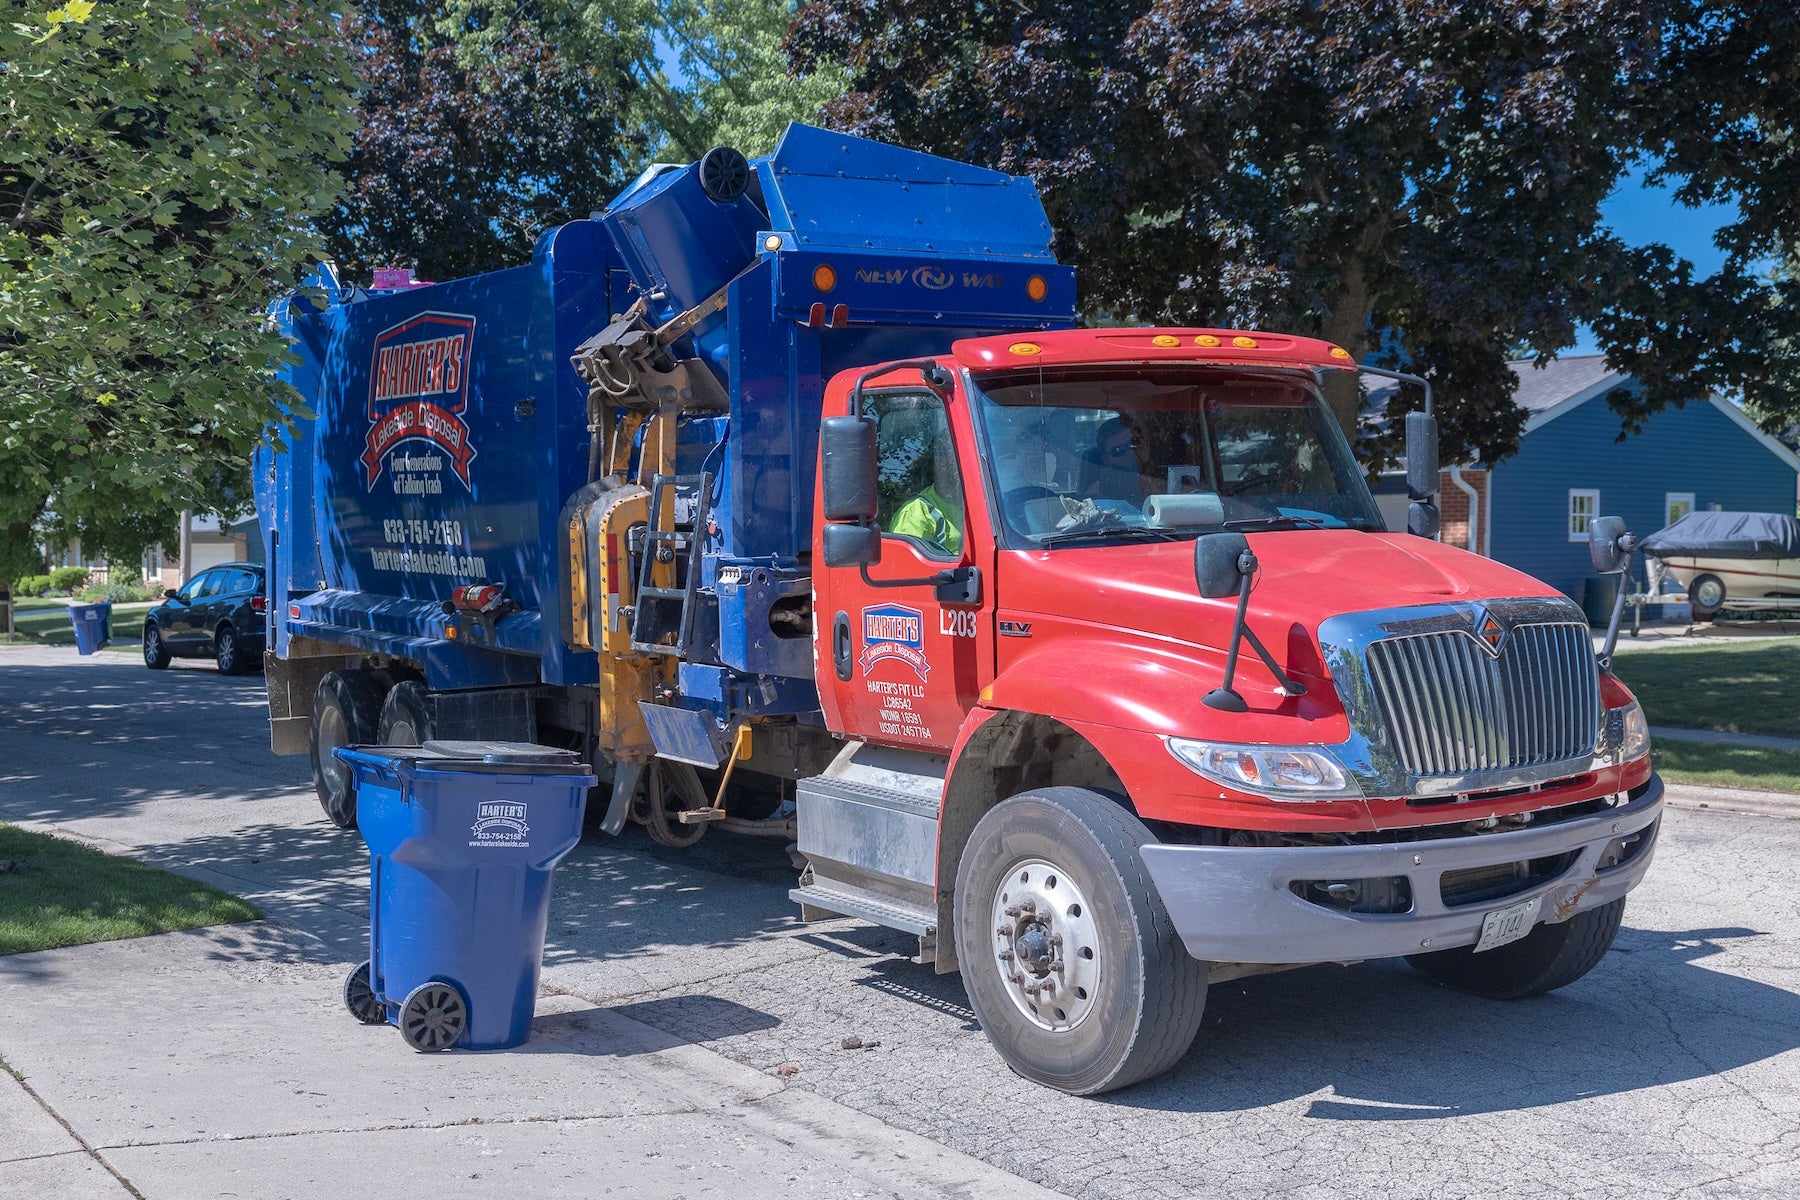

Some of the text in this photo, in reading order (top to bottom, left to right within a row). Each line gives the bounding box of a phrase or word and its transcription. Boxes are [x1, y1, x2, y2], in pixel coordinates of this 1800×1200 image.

[855, 267, 908, 284] NEW
[375, 334, 465, 401] HARTER'S
[372, 404, 462, 453] Lakeside Disposal
[391, 450, 442, 472] Four Generations
[400, 473, 425, 498] Talking
[424, 473, 442, 494] Trash
[383, 519, 462, 546] 833-754-2158
[371, 547, 487, 578] harterslakeside.com
[866, 614, 918, 642] HARTER'S
[939, 608, 977, 638] L203
[866, 642, 922, 665] Lakeside Disposal
[867, 680, 899, 695] HARTER'S
[911, 684, 925, 698] LLC
[879, 709, 922, 725] WDNR 16591
[879, 722, 932, 739] USDOT 2457764
[481, 805, 523, 816] HARTER'S
[478, 819, 522, 829] LAKESIDE DISPOSAL
[468, 840, 530, 848] www.harterslakeside.com
[1496, 913, 1524, 939] 1144
